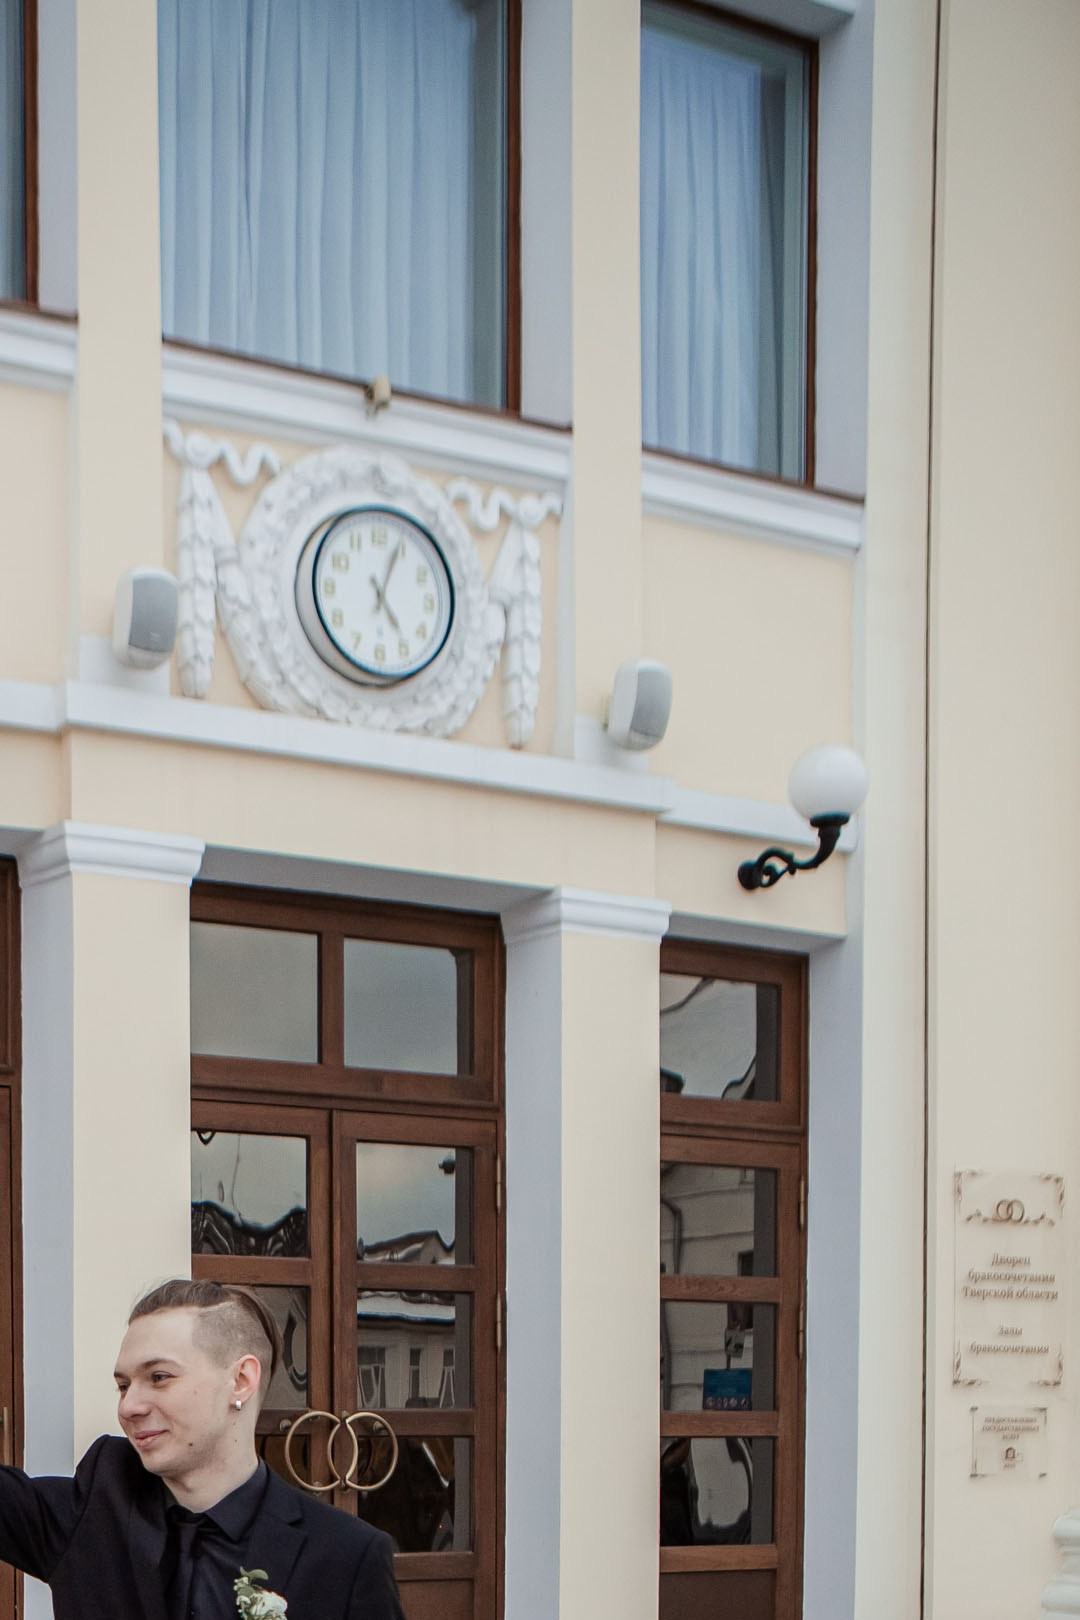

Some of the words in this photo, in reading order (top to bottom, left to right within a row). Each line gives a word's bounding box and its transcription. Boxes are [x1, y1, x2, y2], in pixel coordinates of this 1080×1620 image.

[332, 553, 349, 572] 10
[351, 631, 361, 649] 7
[991, 1251, 1031, 1268] Дворец
[967, 1267, 1056, 1284] бракосочетания
[962, 1285, 1014, 1301] Тверской
[1016, 1286, 1058, 1301] области
[970, 1341, 1050, 1356] бракосочетания
